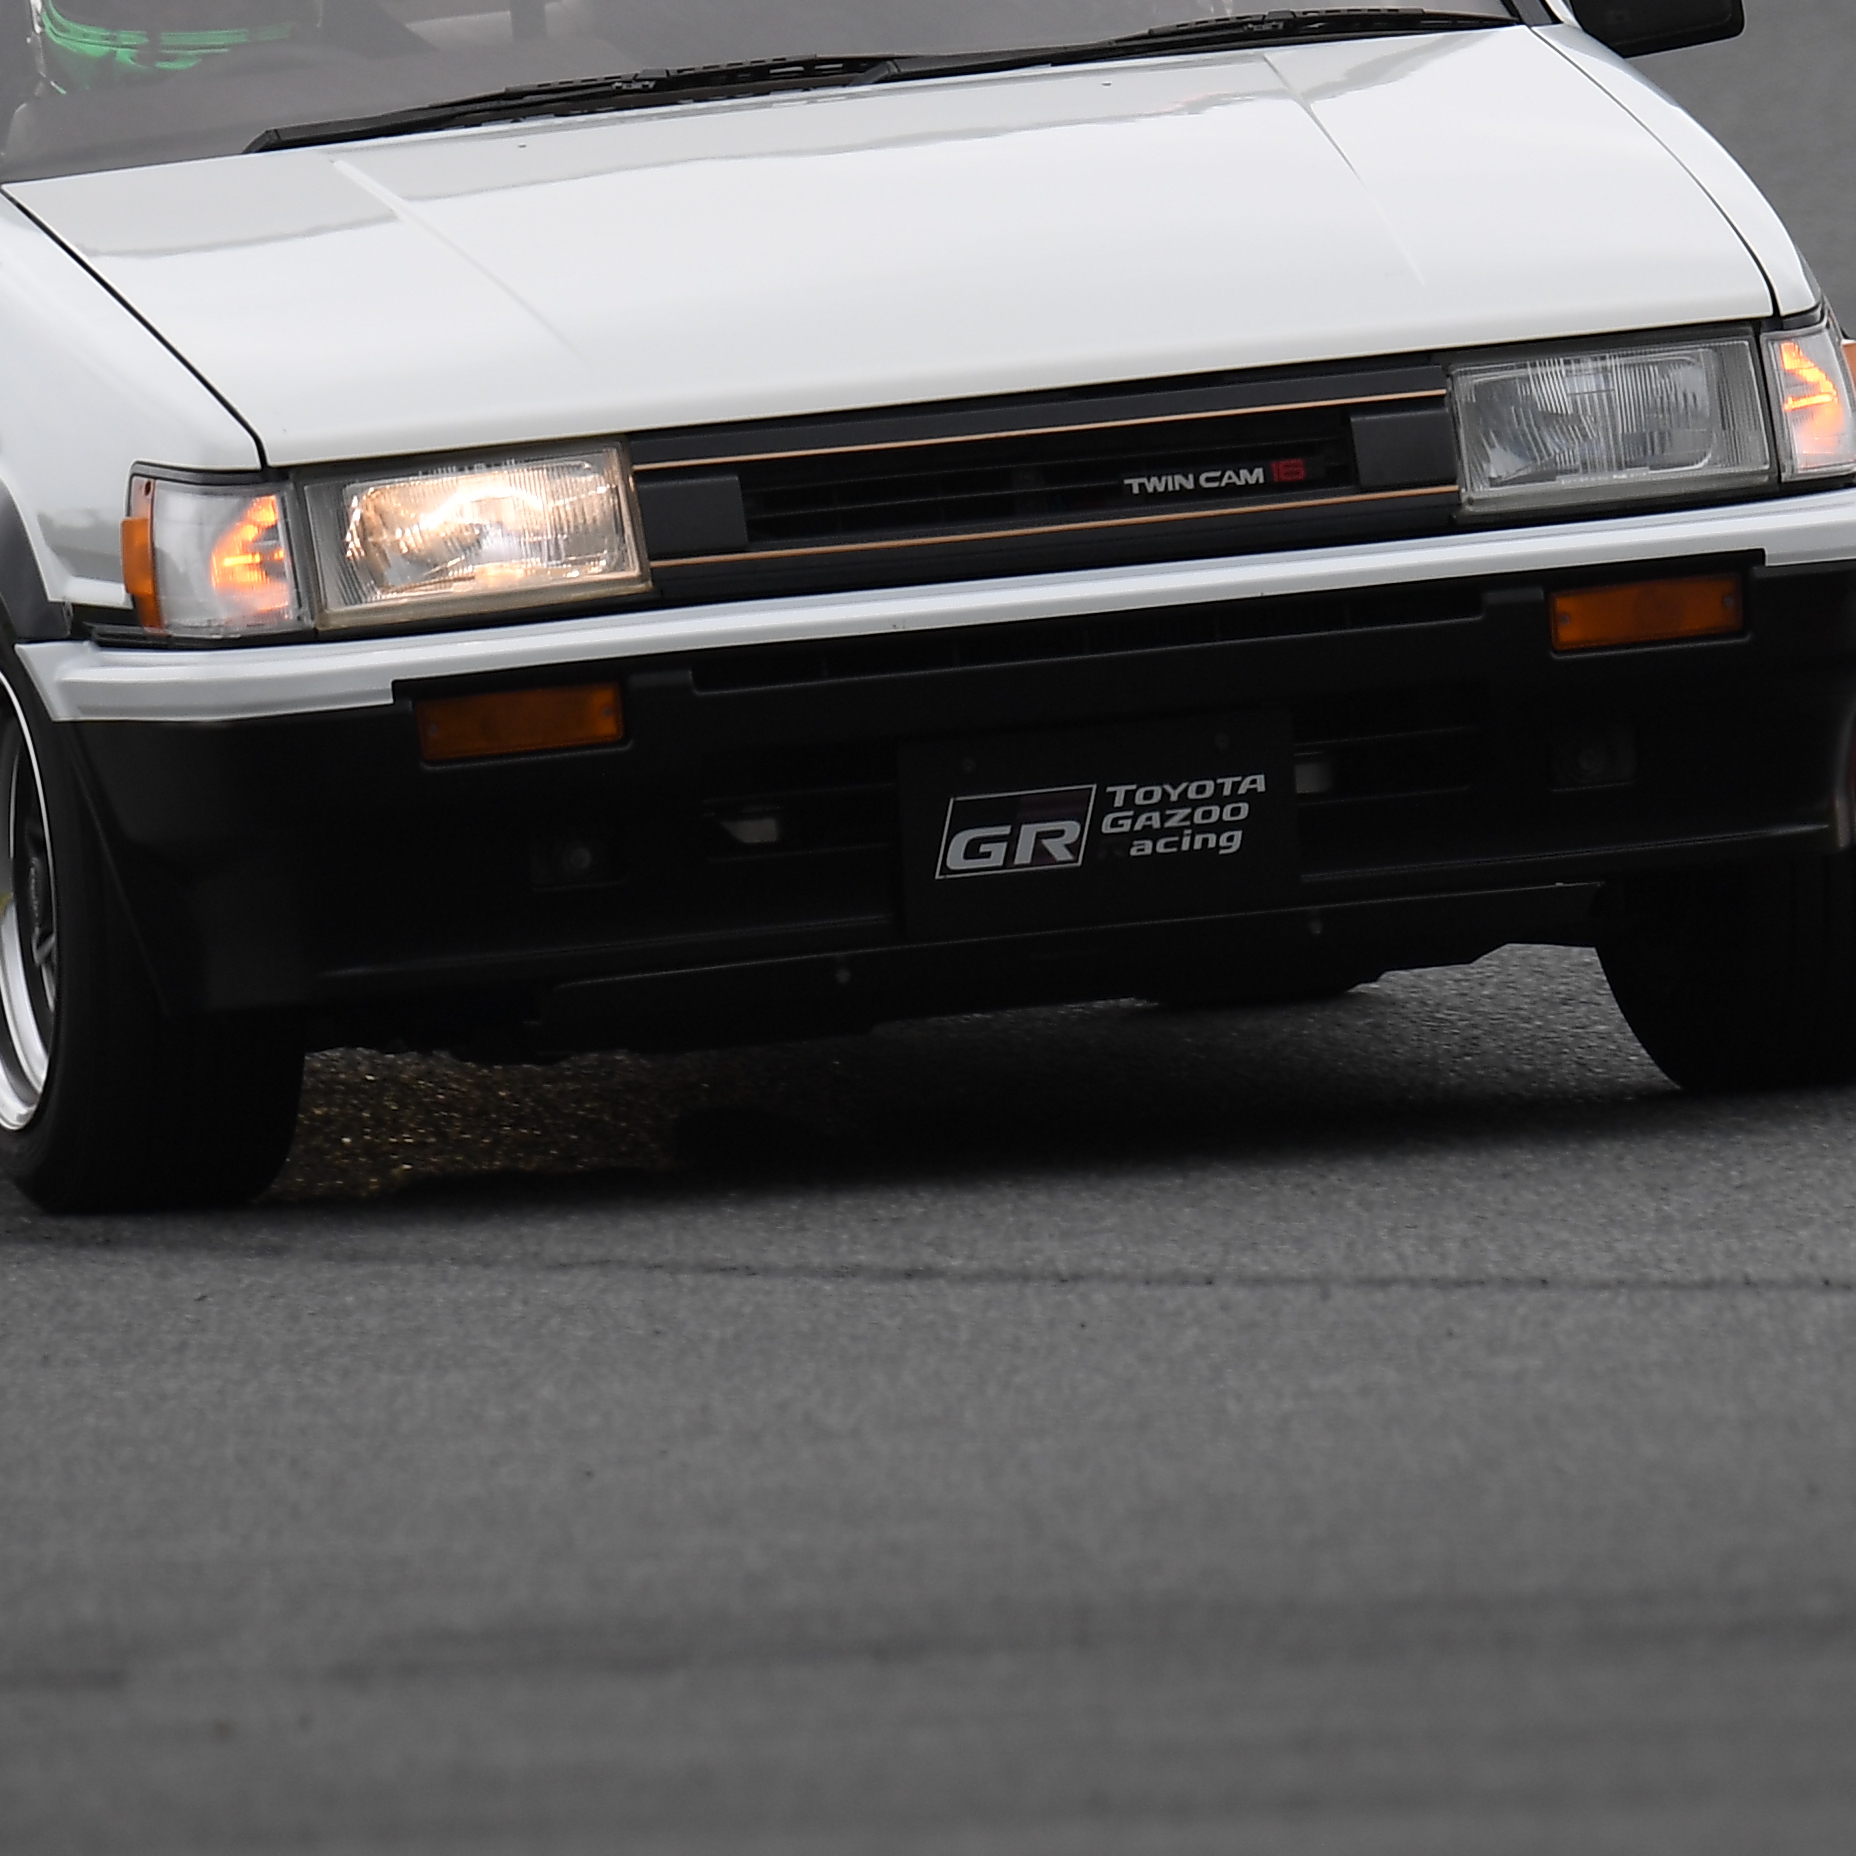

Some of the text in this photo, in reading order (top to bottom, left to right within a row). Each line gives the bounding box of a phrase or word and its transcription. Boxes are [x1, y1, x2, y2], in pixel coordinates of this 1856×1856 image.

[1123, 473, 1194, 495] TWIN
[1198, 467, 1265, 488] CAM
[1105, 772, 1267, 808] TOYOTA
[1100, 801, 1250, 834] GAZOO
[945, 819, 1081, 871] GR
[1096, 828, 1244, 856] acing
